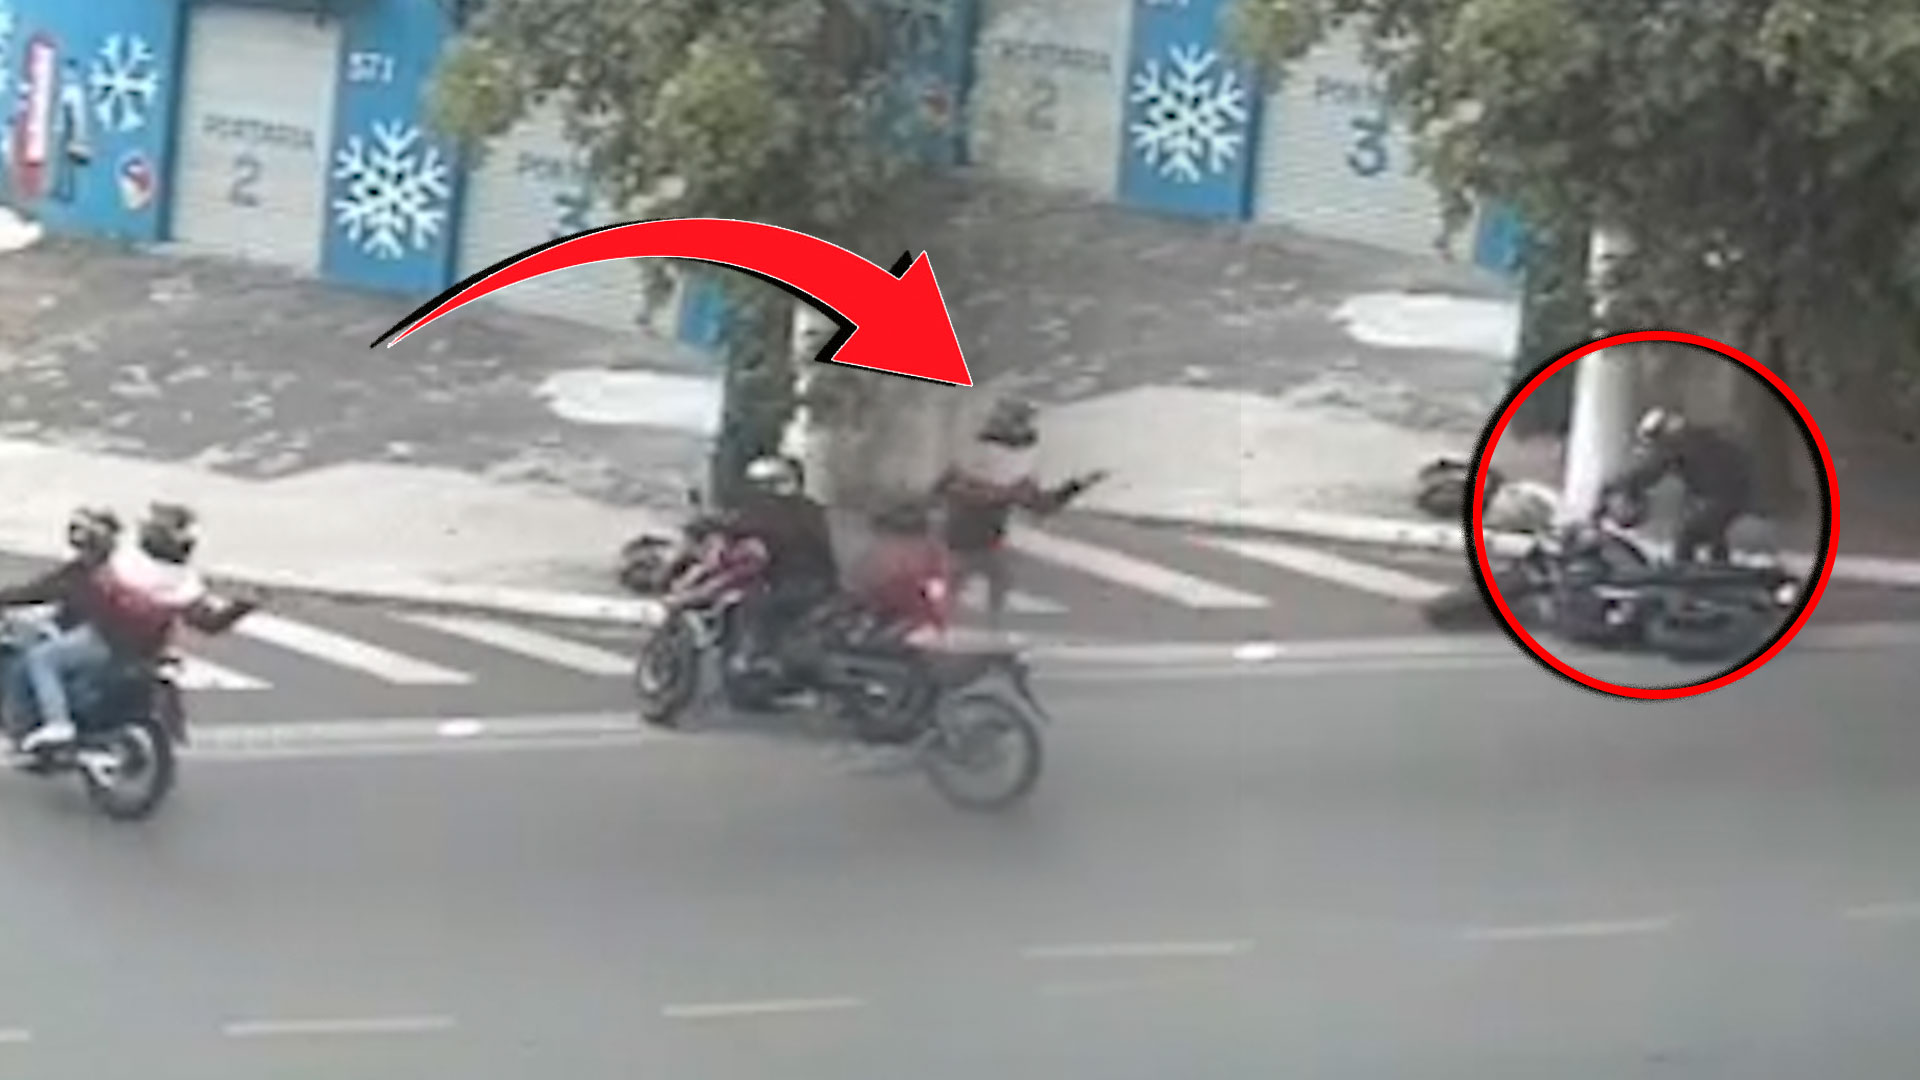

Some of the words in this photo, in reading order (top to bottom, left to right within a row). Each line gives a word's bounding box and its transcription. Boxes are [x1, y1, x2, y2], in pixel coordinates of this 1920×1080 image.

[1026, 78, 1058, 131] 2
[1347, 117, 1387, 177] 3
[229, 154, 261, 207] 2
